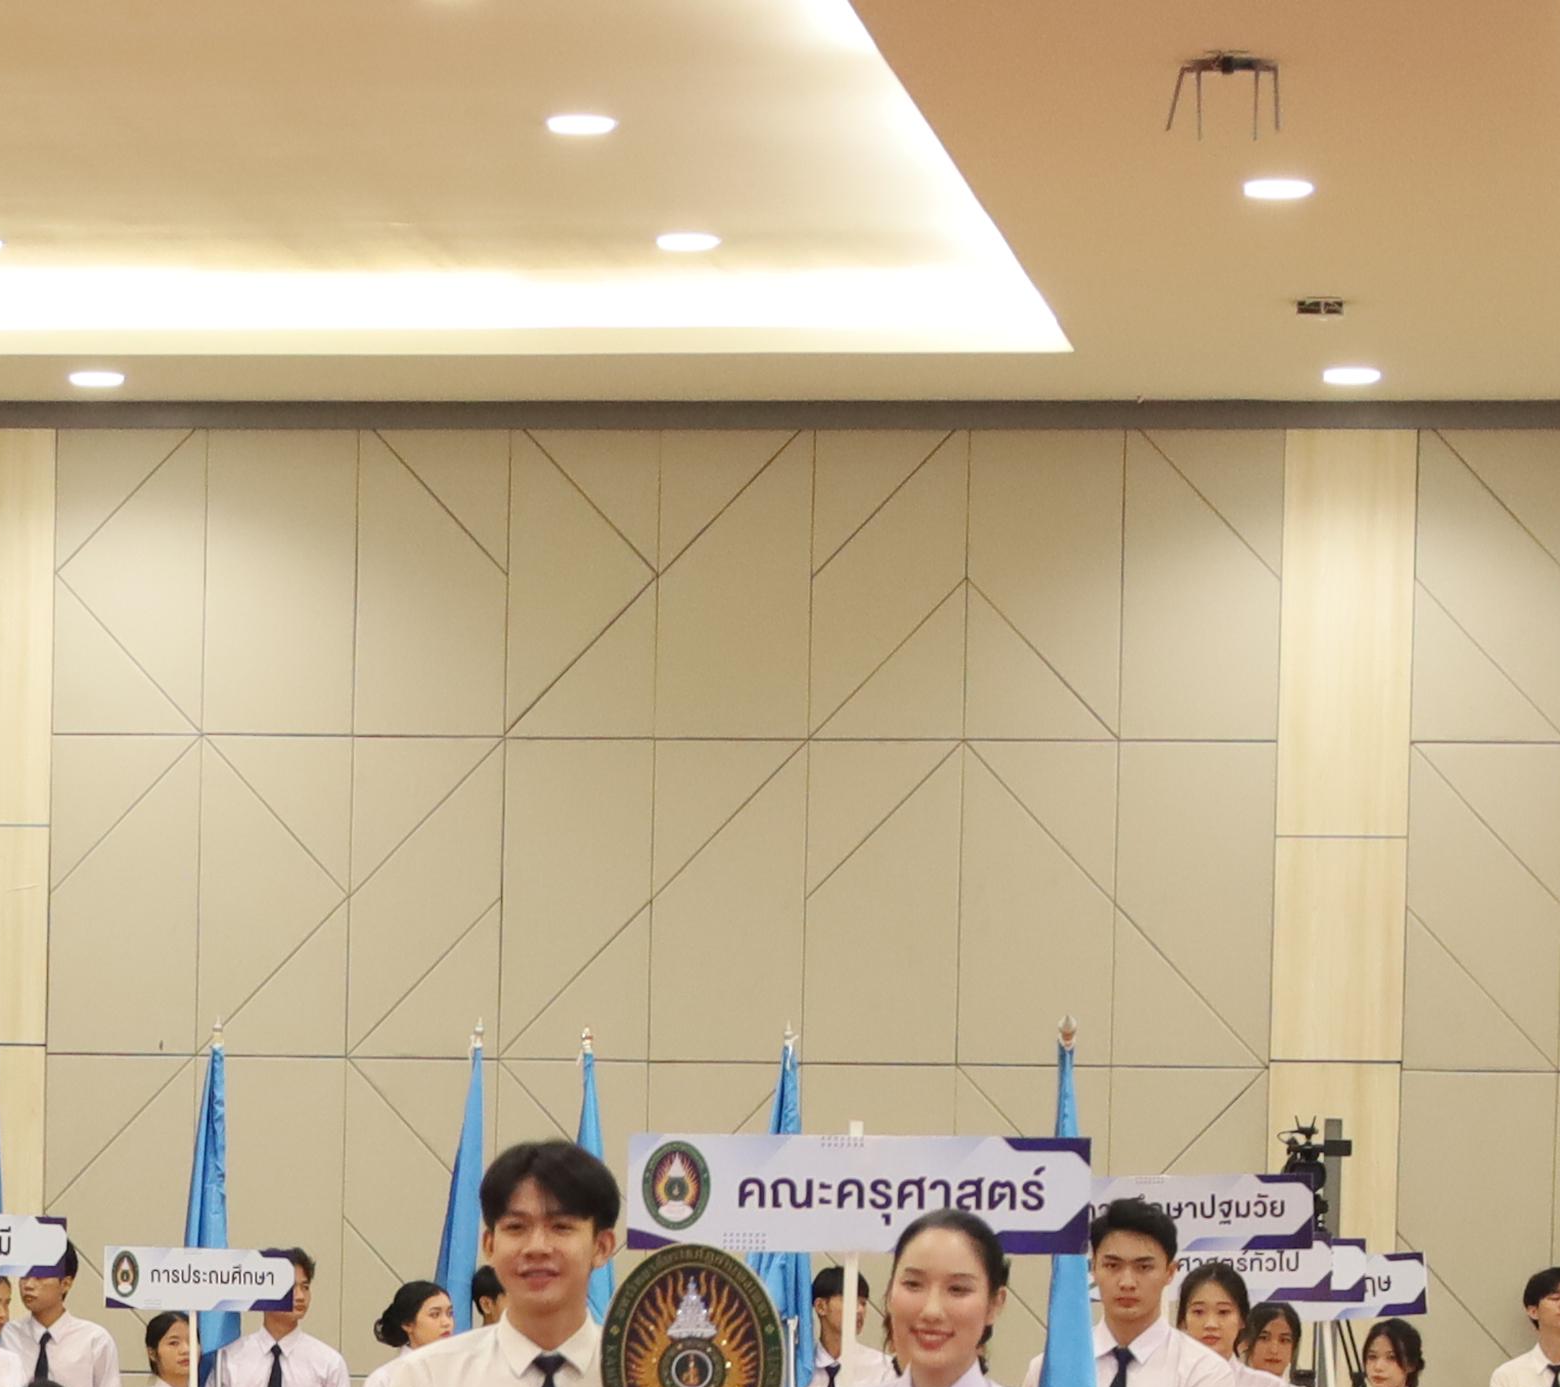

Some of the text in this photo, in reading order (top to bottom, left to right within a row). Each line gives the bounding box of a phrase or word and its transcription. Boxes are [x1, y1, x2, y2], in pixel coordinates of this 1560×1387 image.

[737, 1166, 1046, 1226] คณะครุศาสตร์
[150, 1264, 275, 1286] การประถมศึกษา
